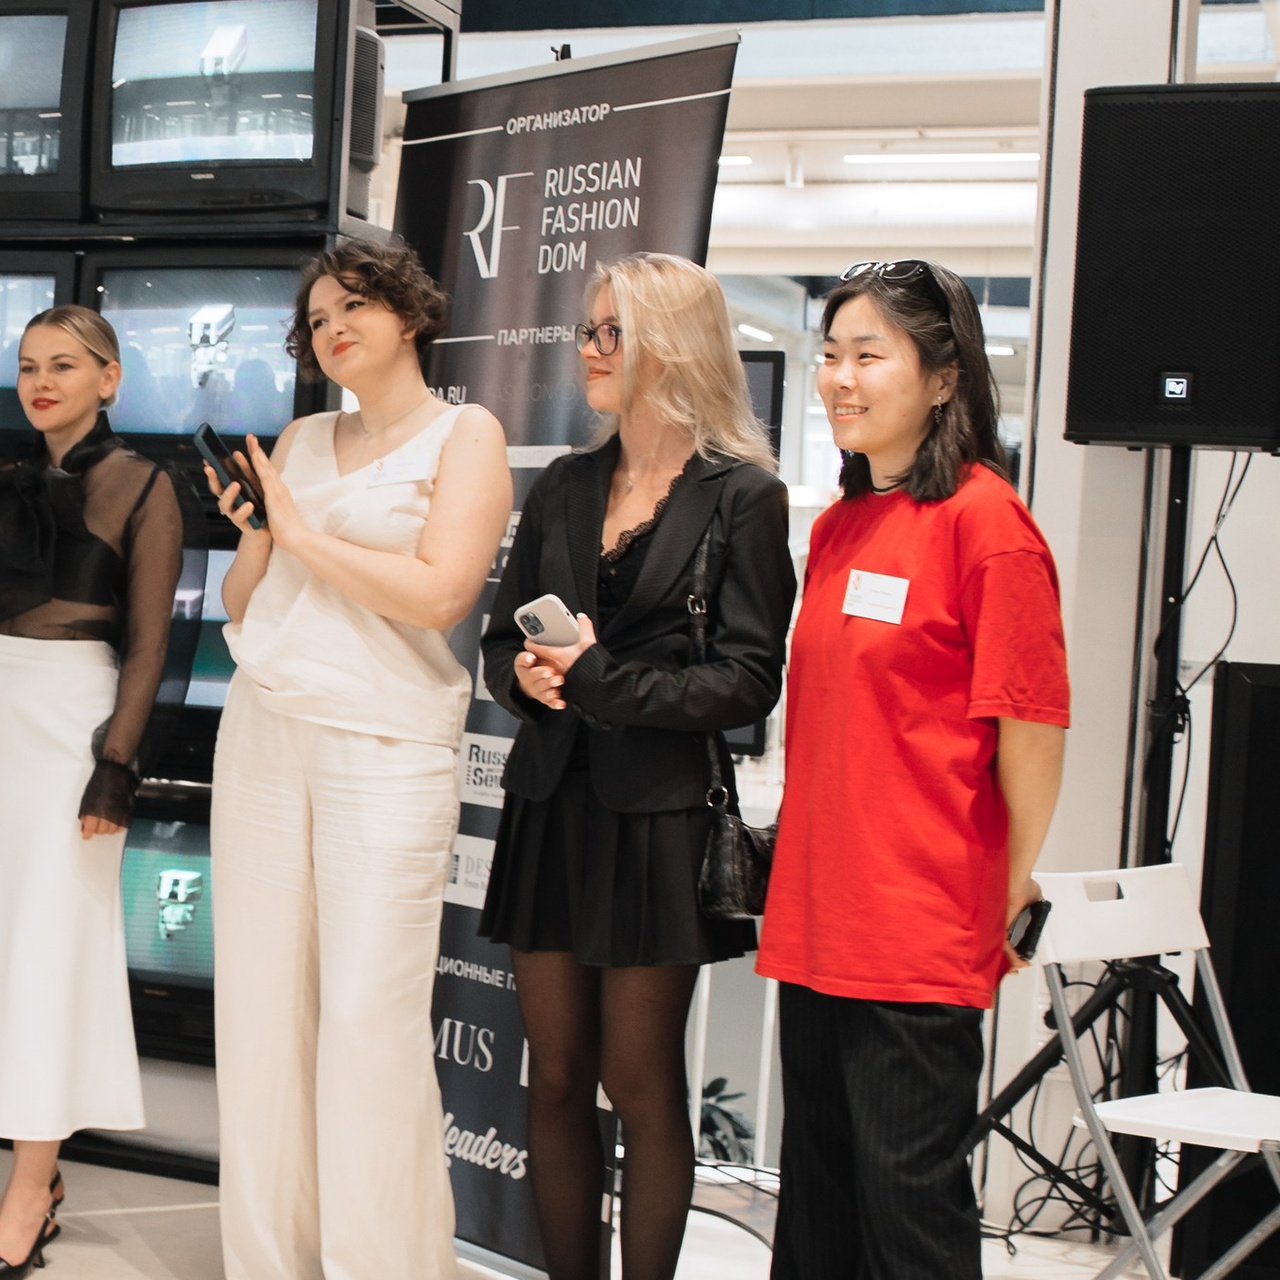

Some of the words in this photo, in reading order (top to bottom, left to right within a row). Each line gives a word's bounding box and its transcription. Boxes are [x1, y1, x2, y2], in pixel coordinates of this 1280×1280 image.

[506, 103, 611, 135] ОРГАНИЗАТОР
[544, 156, 642, 199] RUSSIAN
[541, 196, 641, 236] FASHION
[537, 240, 588, 275] DOM
[497, 325, 576, 347] ПАРТНЕРЫ
